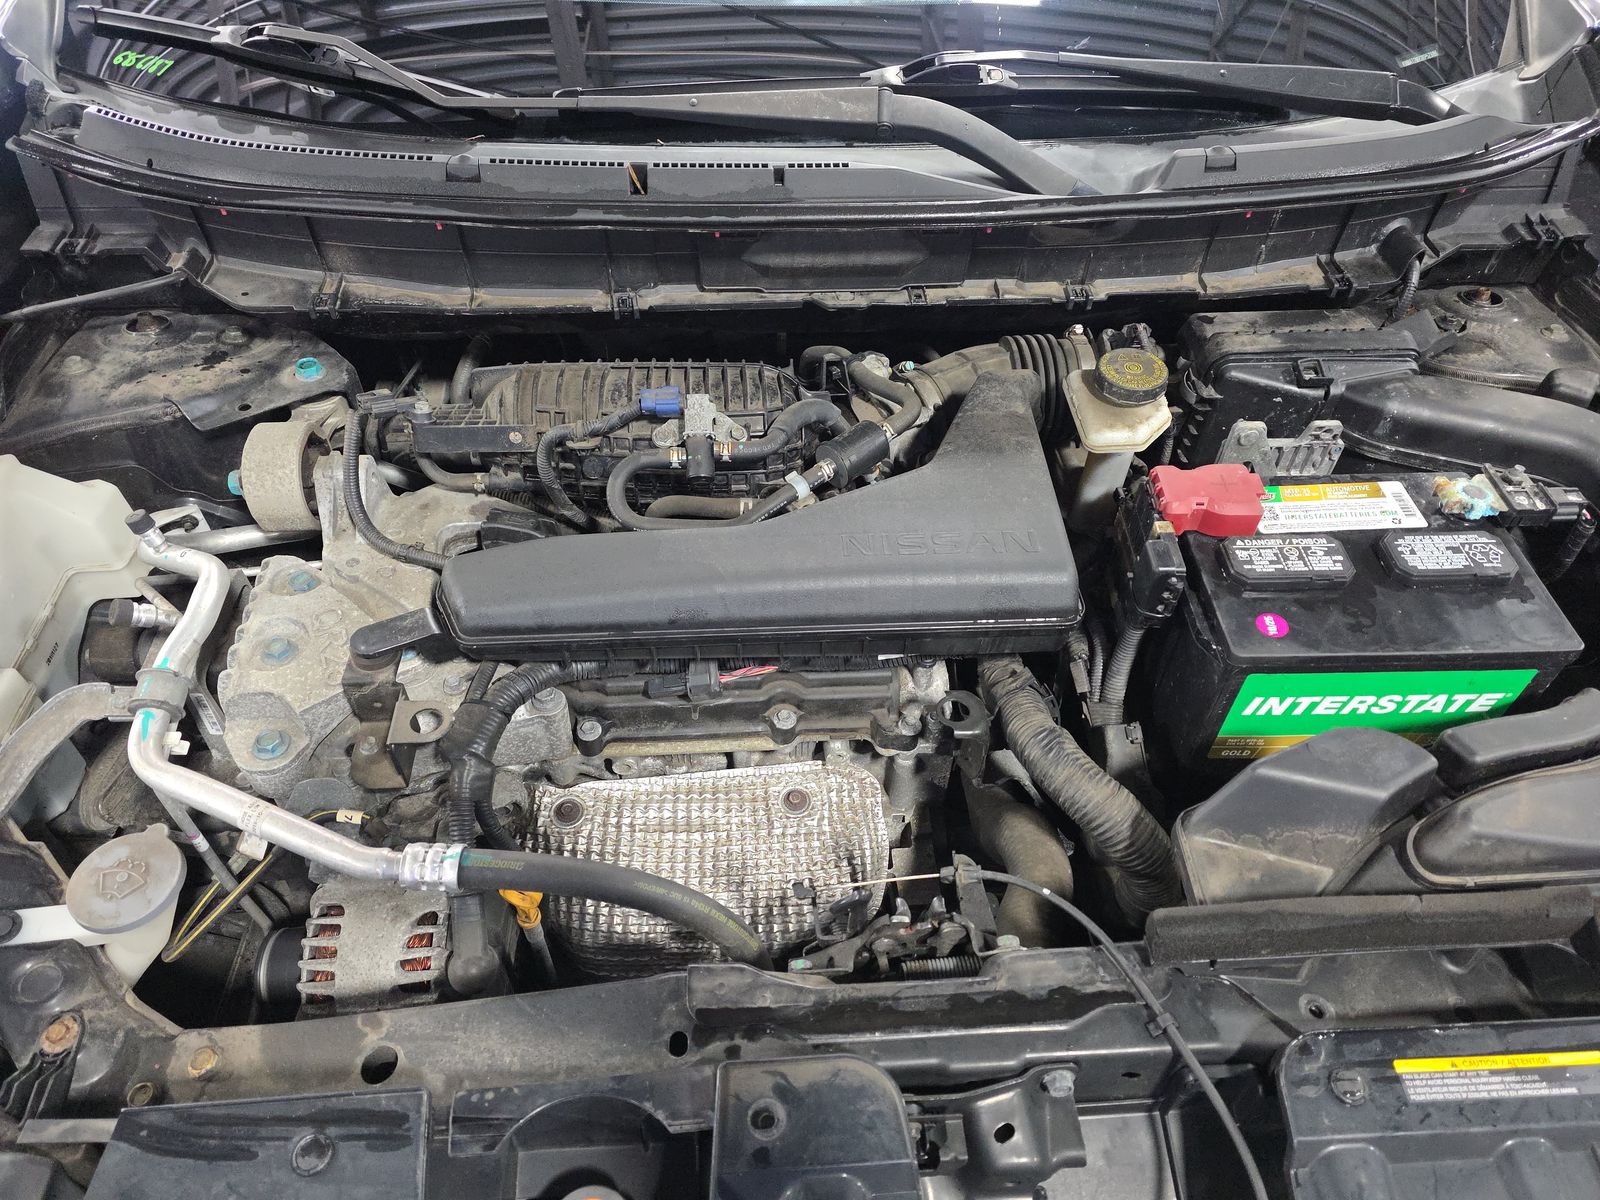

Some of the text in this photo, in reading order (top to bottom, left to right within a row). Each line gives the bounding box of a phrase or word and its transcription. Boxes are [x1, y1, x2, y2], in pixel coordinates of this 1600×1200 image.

[840, 528, 1041, 558] NISSAN
[1292, 537, 1328, 545] POISON
[1241, 692, 1507, 716] INTERSTATE
[1462, 1058, 1497, 1067] CAUTION
[1507, 1056, 1550, 1066] ATTENTION
